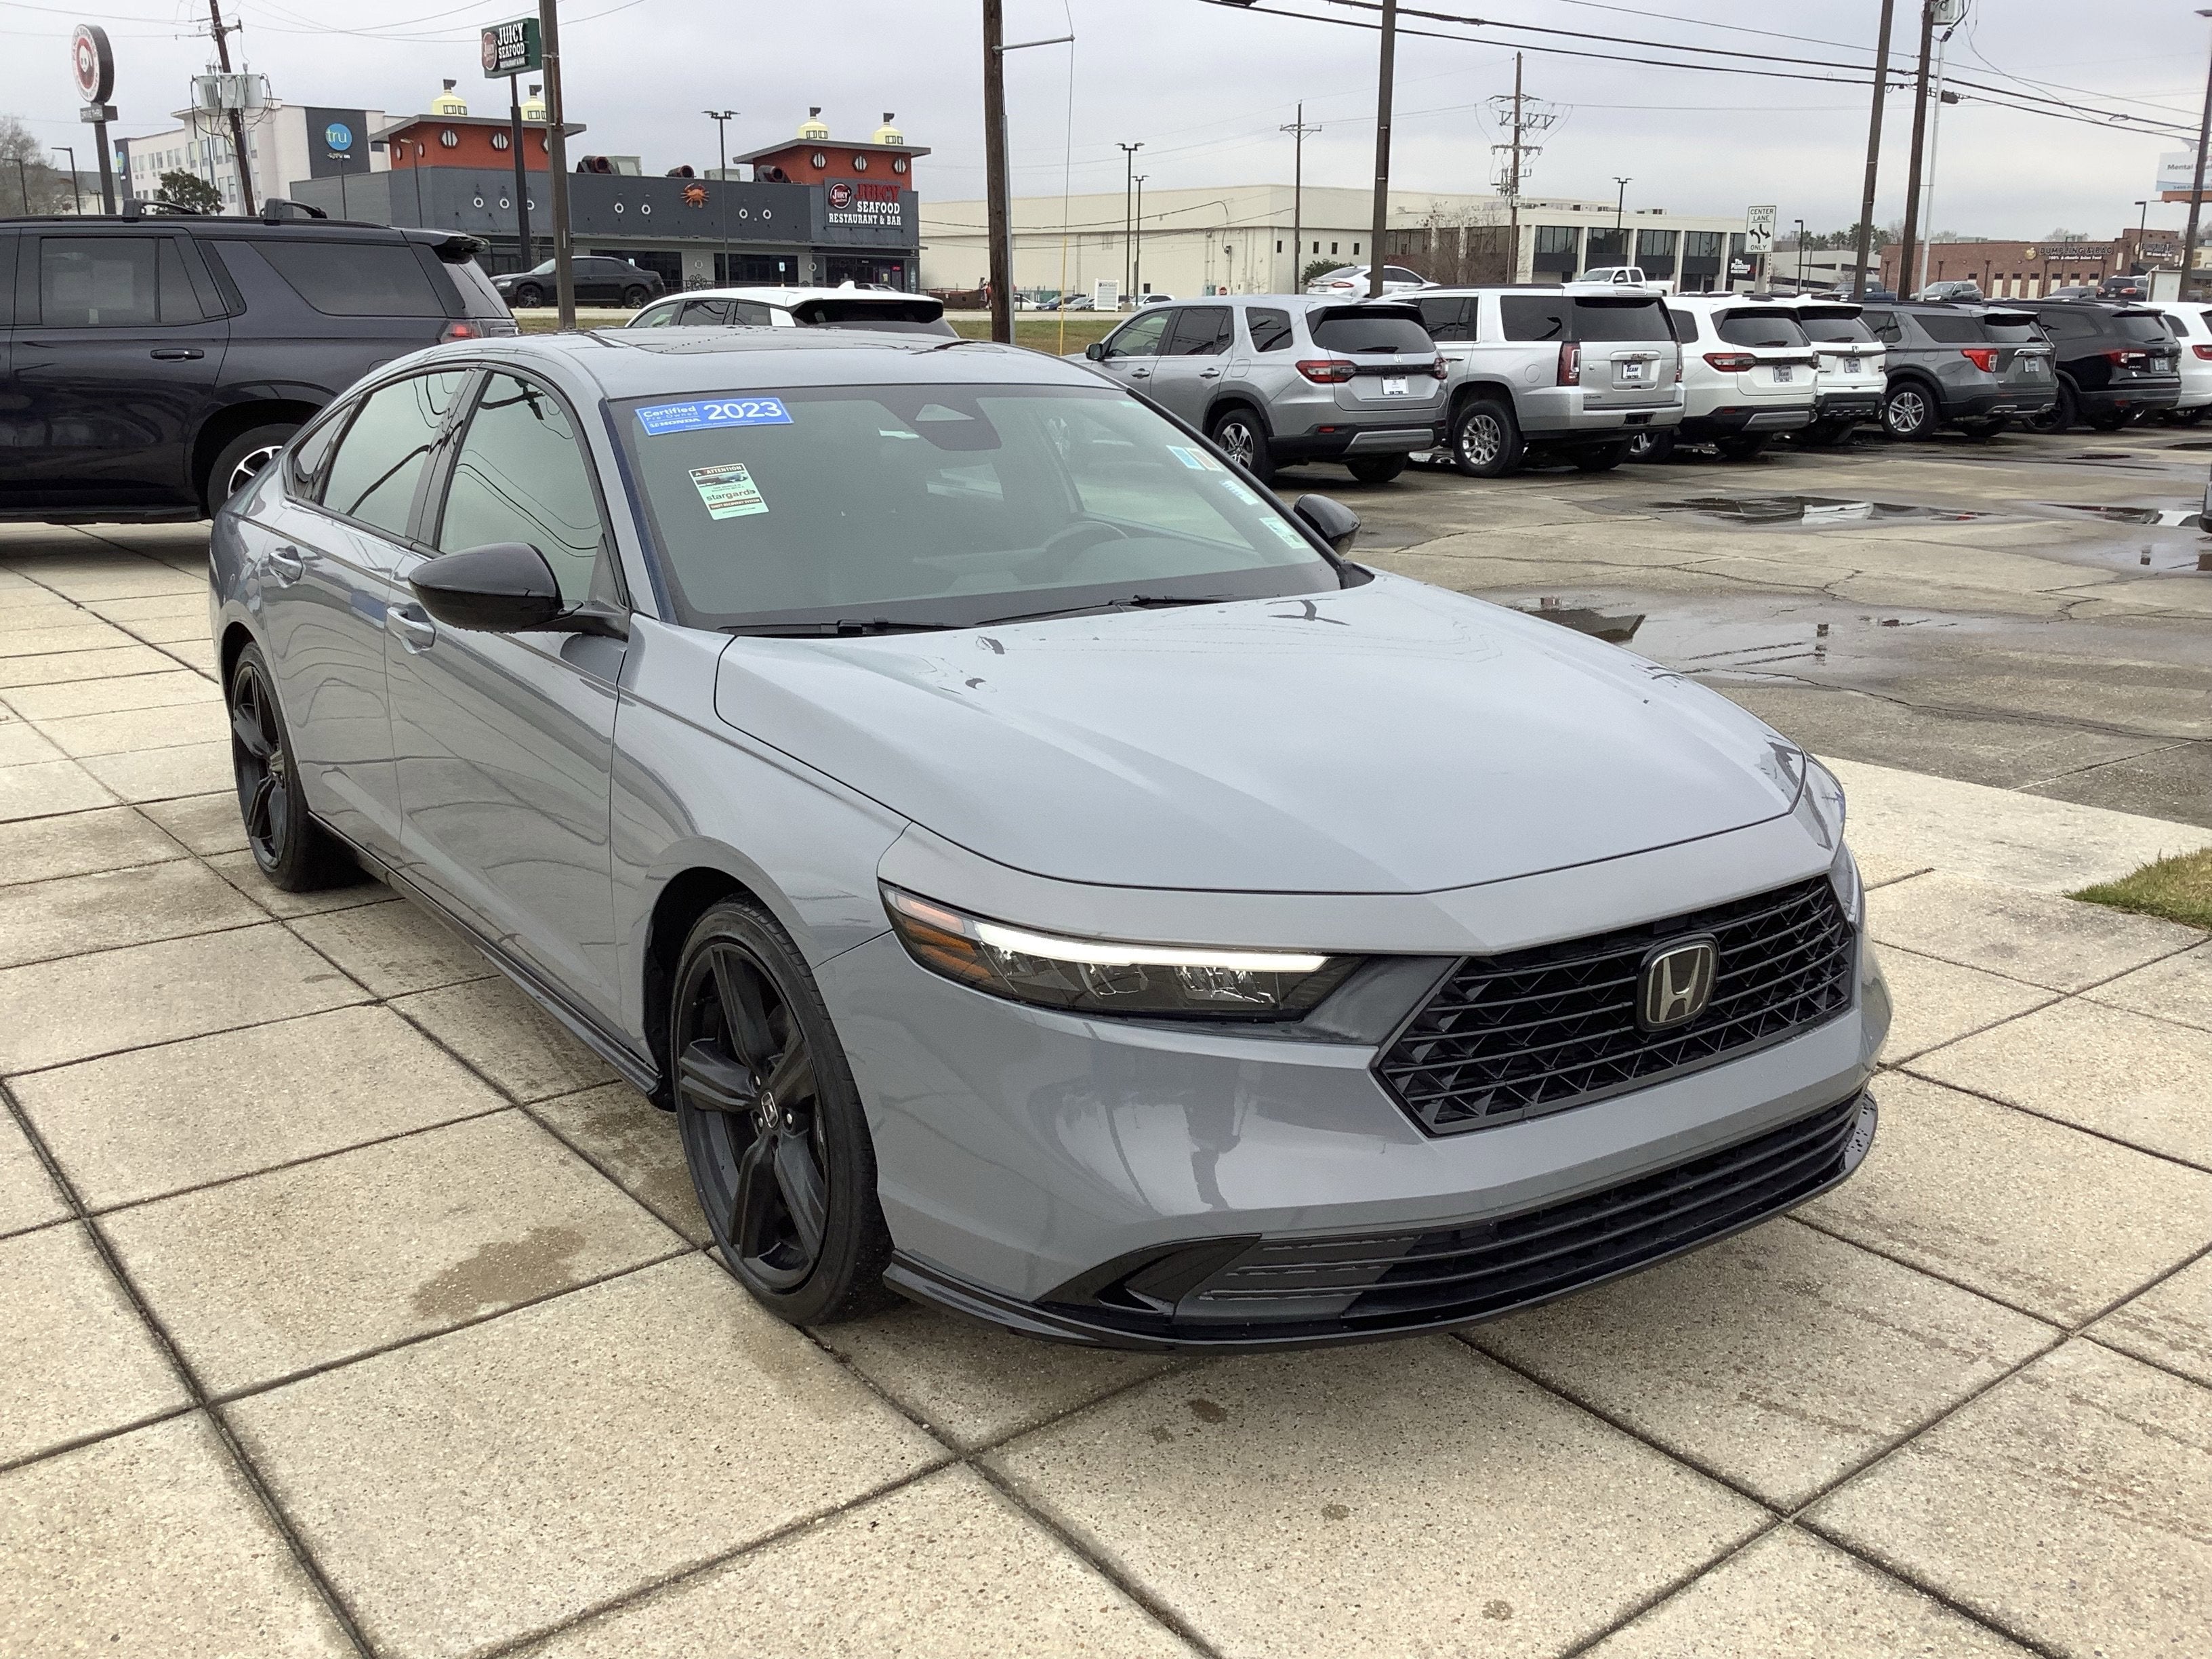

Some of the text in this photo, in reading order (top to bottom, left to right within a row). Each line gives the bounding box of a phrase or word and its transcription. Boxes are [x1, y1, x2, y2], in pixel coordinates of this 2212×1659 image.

[497, 22, 524, 46] JUICY
[498, 42, 525, 59] SEAFOOD
[326, 129, 347, 143] tru
[855, 184, 900, 201] JUICY
[857, 201, 900, 214] SEAFOOD
[829, 213, 901, 226] RESTAURANT & BAR
[2039, 247, 2112, 255] DUMPLING & BAO
[644, 405, 697, 417] Certified
[703, 402, 782, 420] 2023
[659, 418, 701, 426] HONDA
[706, 466, 742, 474] ATTENTION
